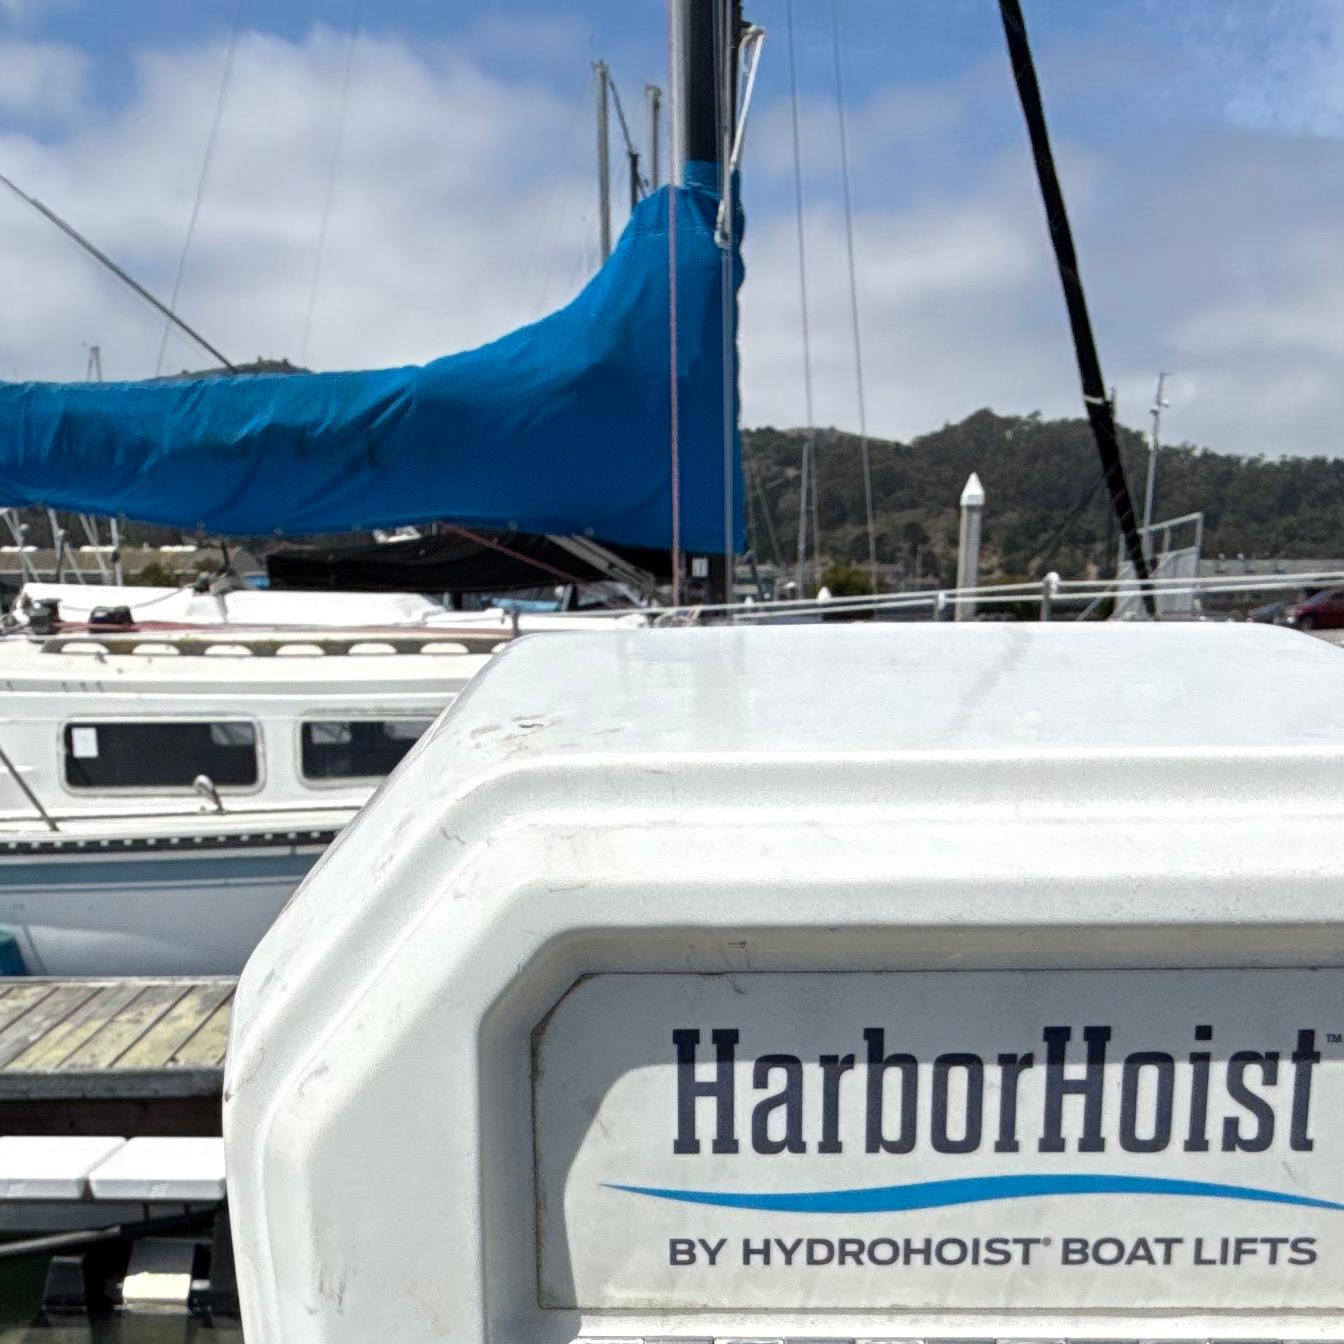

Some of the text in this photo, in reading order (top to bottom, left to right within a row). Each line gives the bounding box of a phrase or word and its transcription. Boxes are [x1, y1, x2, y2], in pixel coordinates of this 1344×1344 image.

[669, 1237, 728, 1266] BY
[1061, 1236, 1184, 1266] BOAT
[1192, 1236, 1318, 1266] LIFTS
